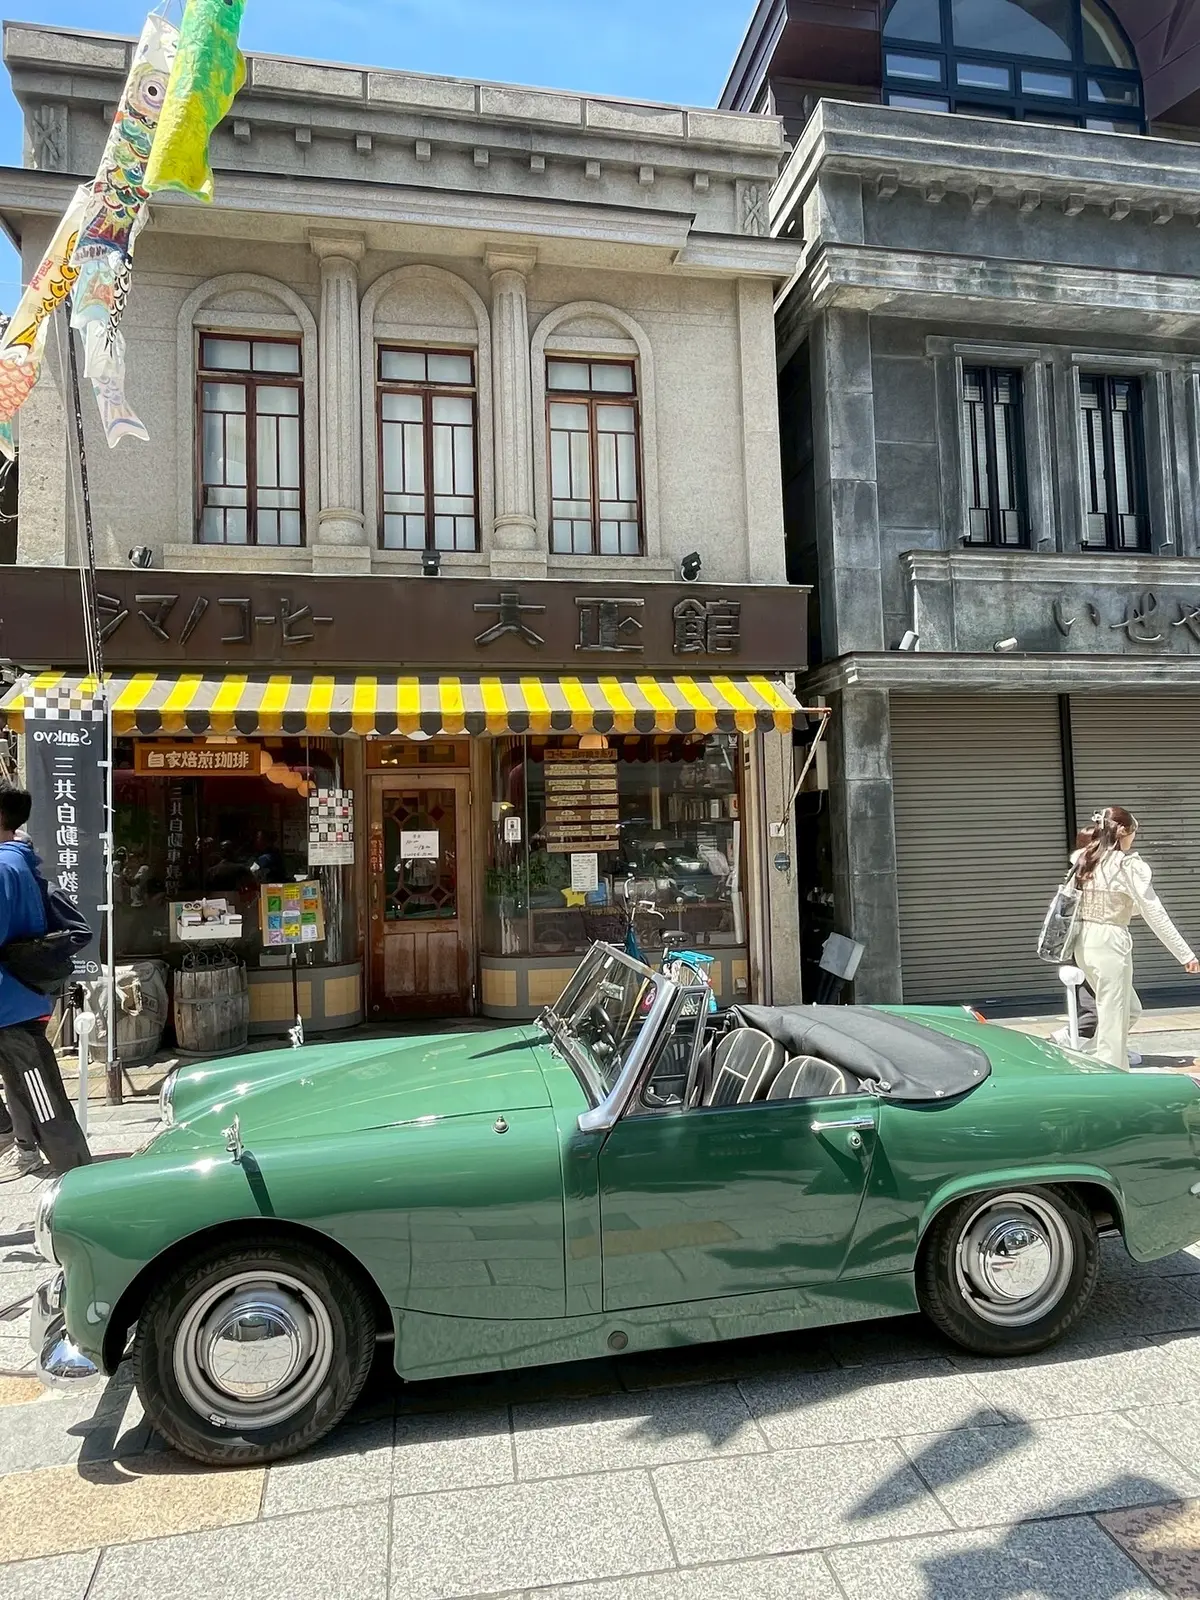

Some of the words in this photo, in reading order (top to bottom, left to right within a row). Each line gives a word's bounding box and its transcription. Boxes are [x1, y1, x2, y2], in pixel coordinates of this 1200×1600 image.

[89, 592, 335, 647] シマノコーヒー
[473, 592, 742, 655] 大正館
[147, 751, 250, 769] 自家焙煎珈琲
